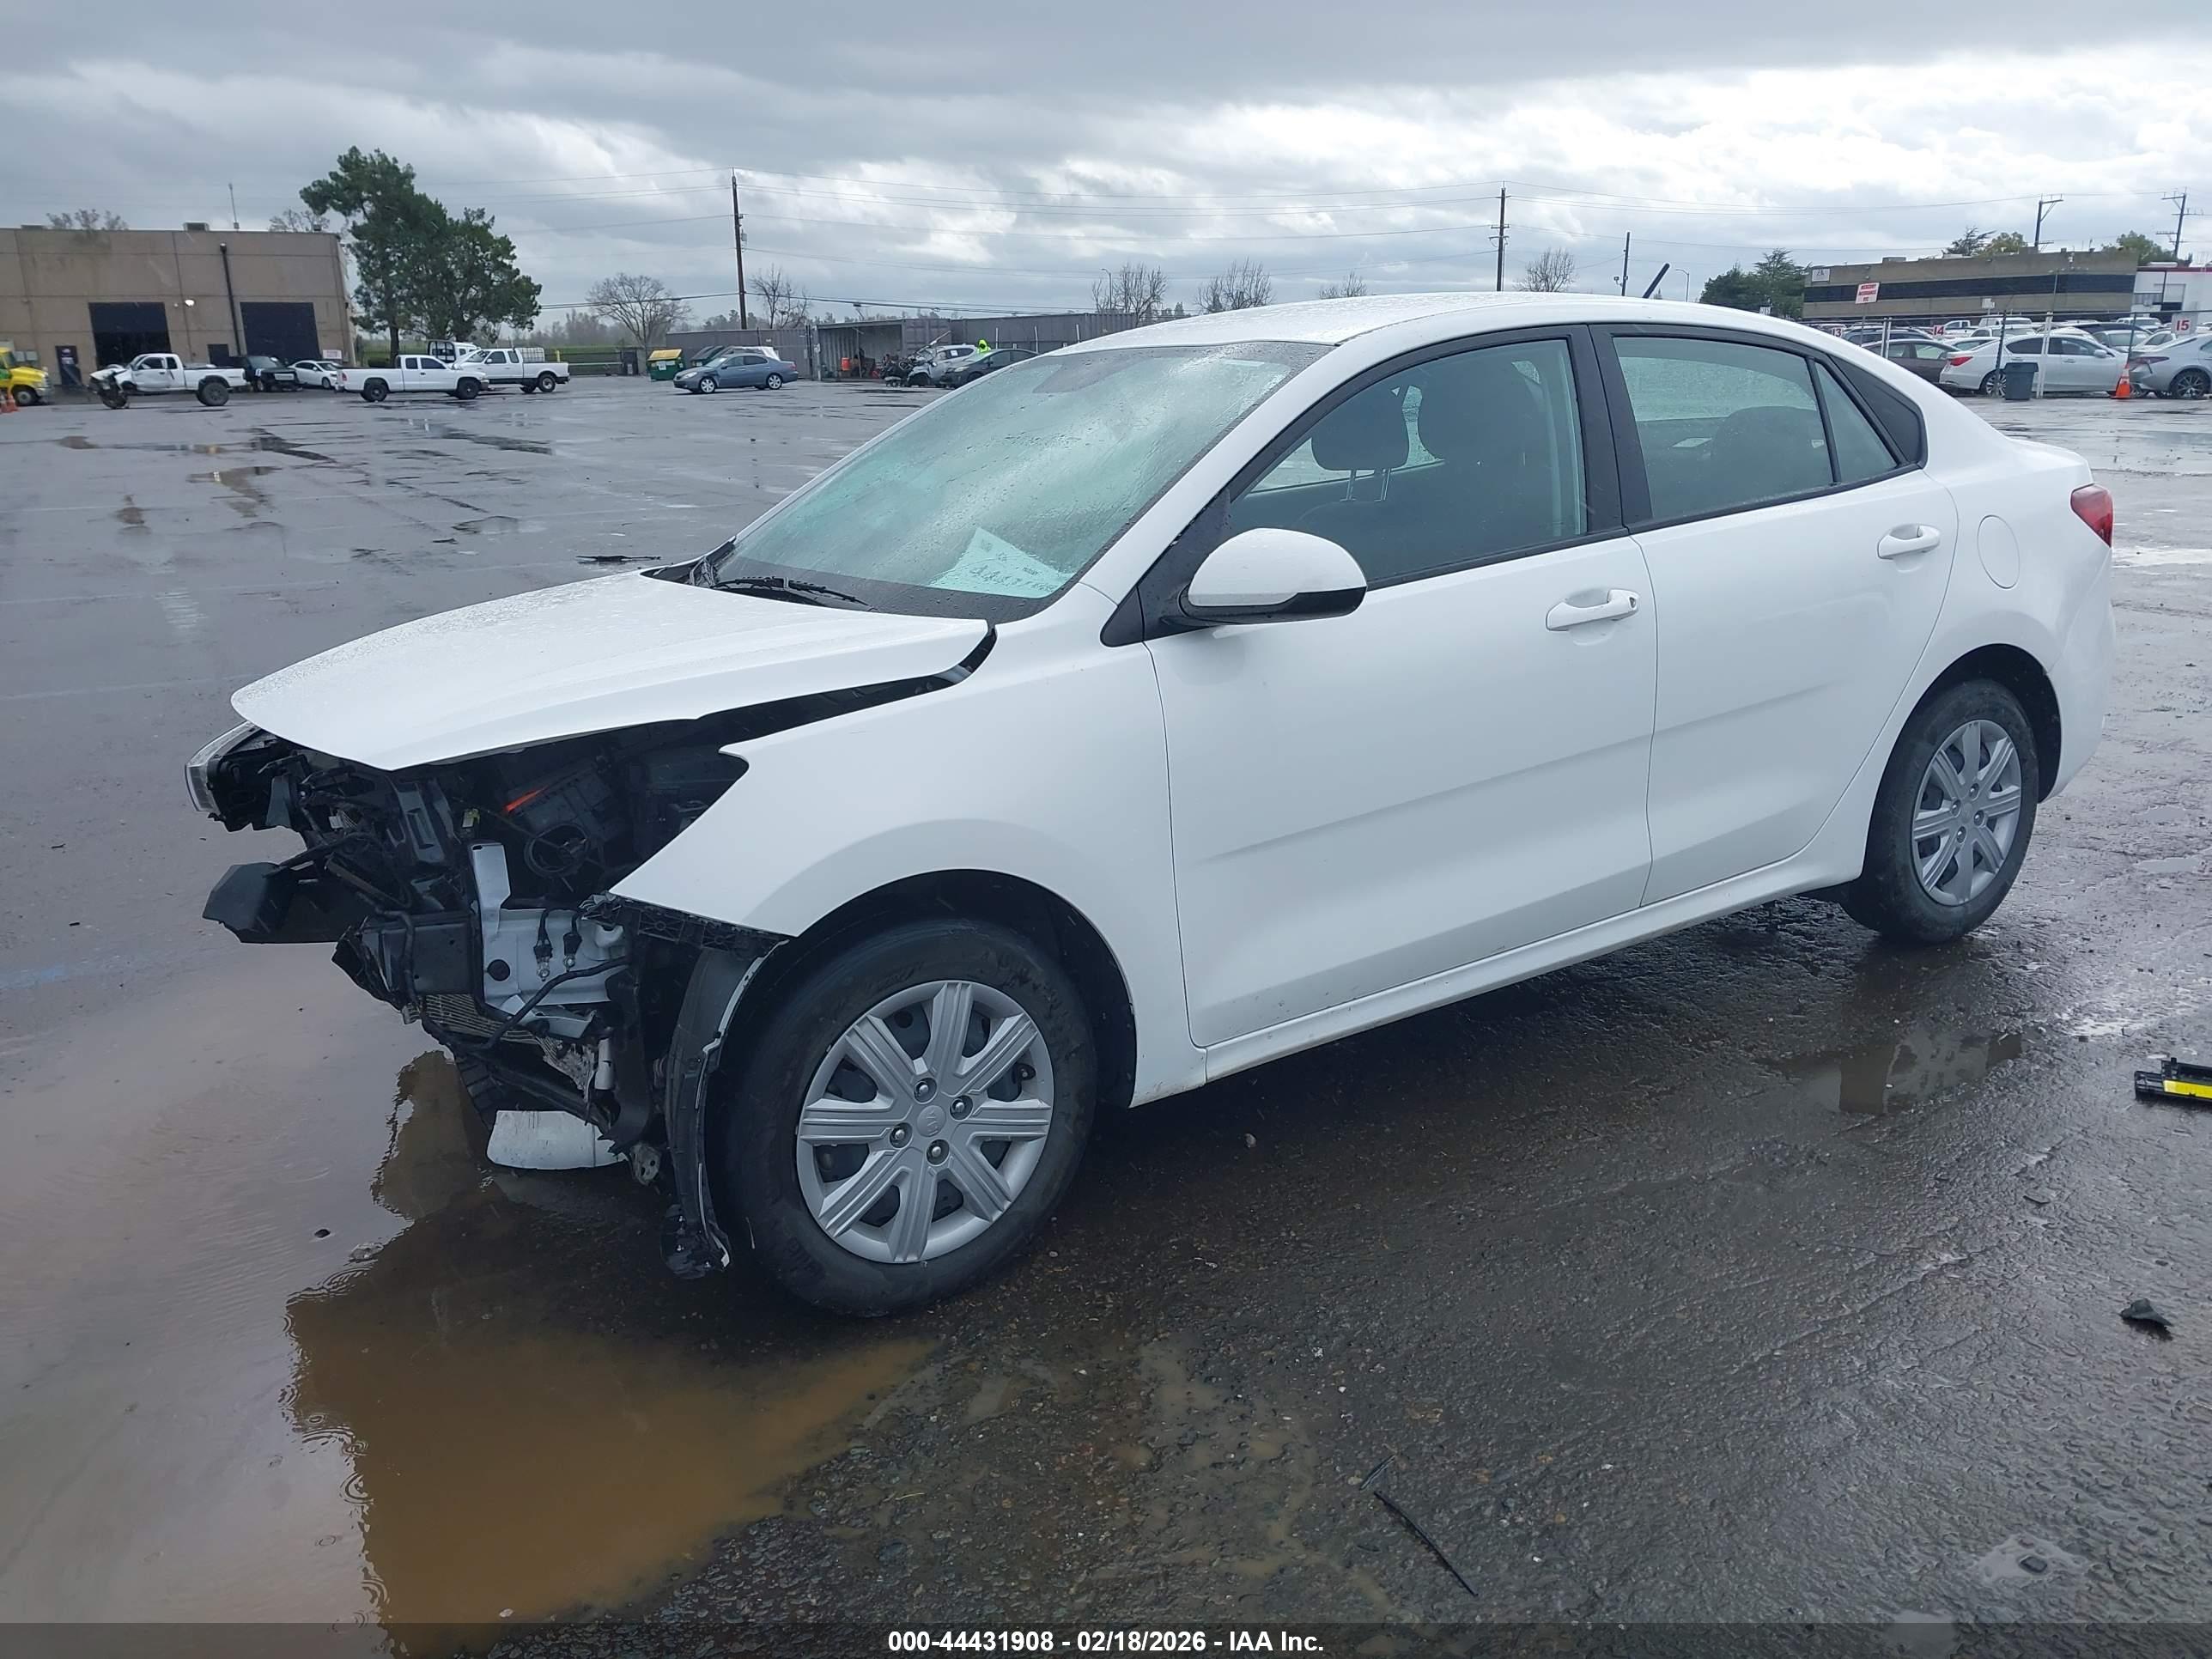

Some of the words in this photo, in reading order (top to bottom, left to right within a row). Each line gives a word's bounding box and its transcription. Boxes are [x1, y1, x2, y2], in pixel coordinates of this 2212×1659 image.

[1934, 325, 1945, 336] 14
[2176, 319, 2190, 331] 15
[1832, 327, 1842, 337] 13
